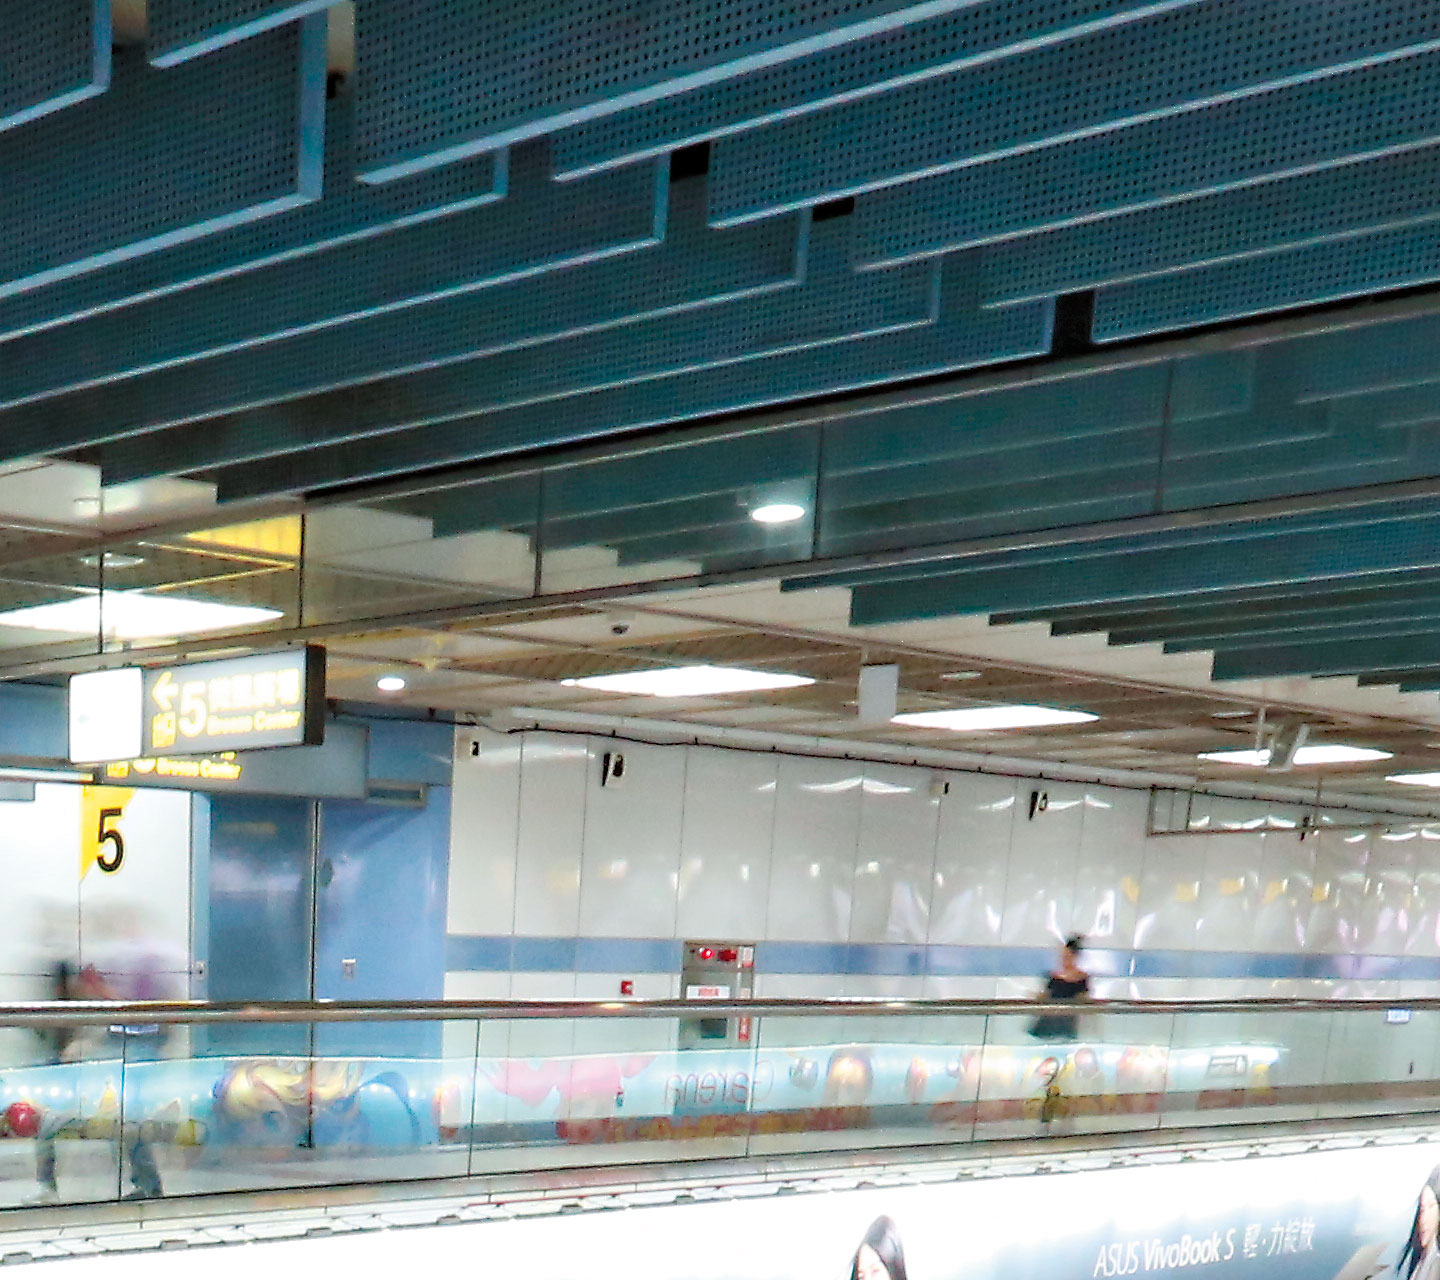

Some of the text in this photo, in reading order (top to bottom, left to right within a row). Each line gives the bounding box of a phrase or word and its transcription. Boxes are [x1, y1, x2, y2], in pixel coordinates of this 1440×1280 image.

[178, 680, 207, 738] 5
[96, 807, 125, 874] 5
[1092, 1228, 1237, 1279] ASUS VivoBook S
